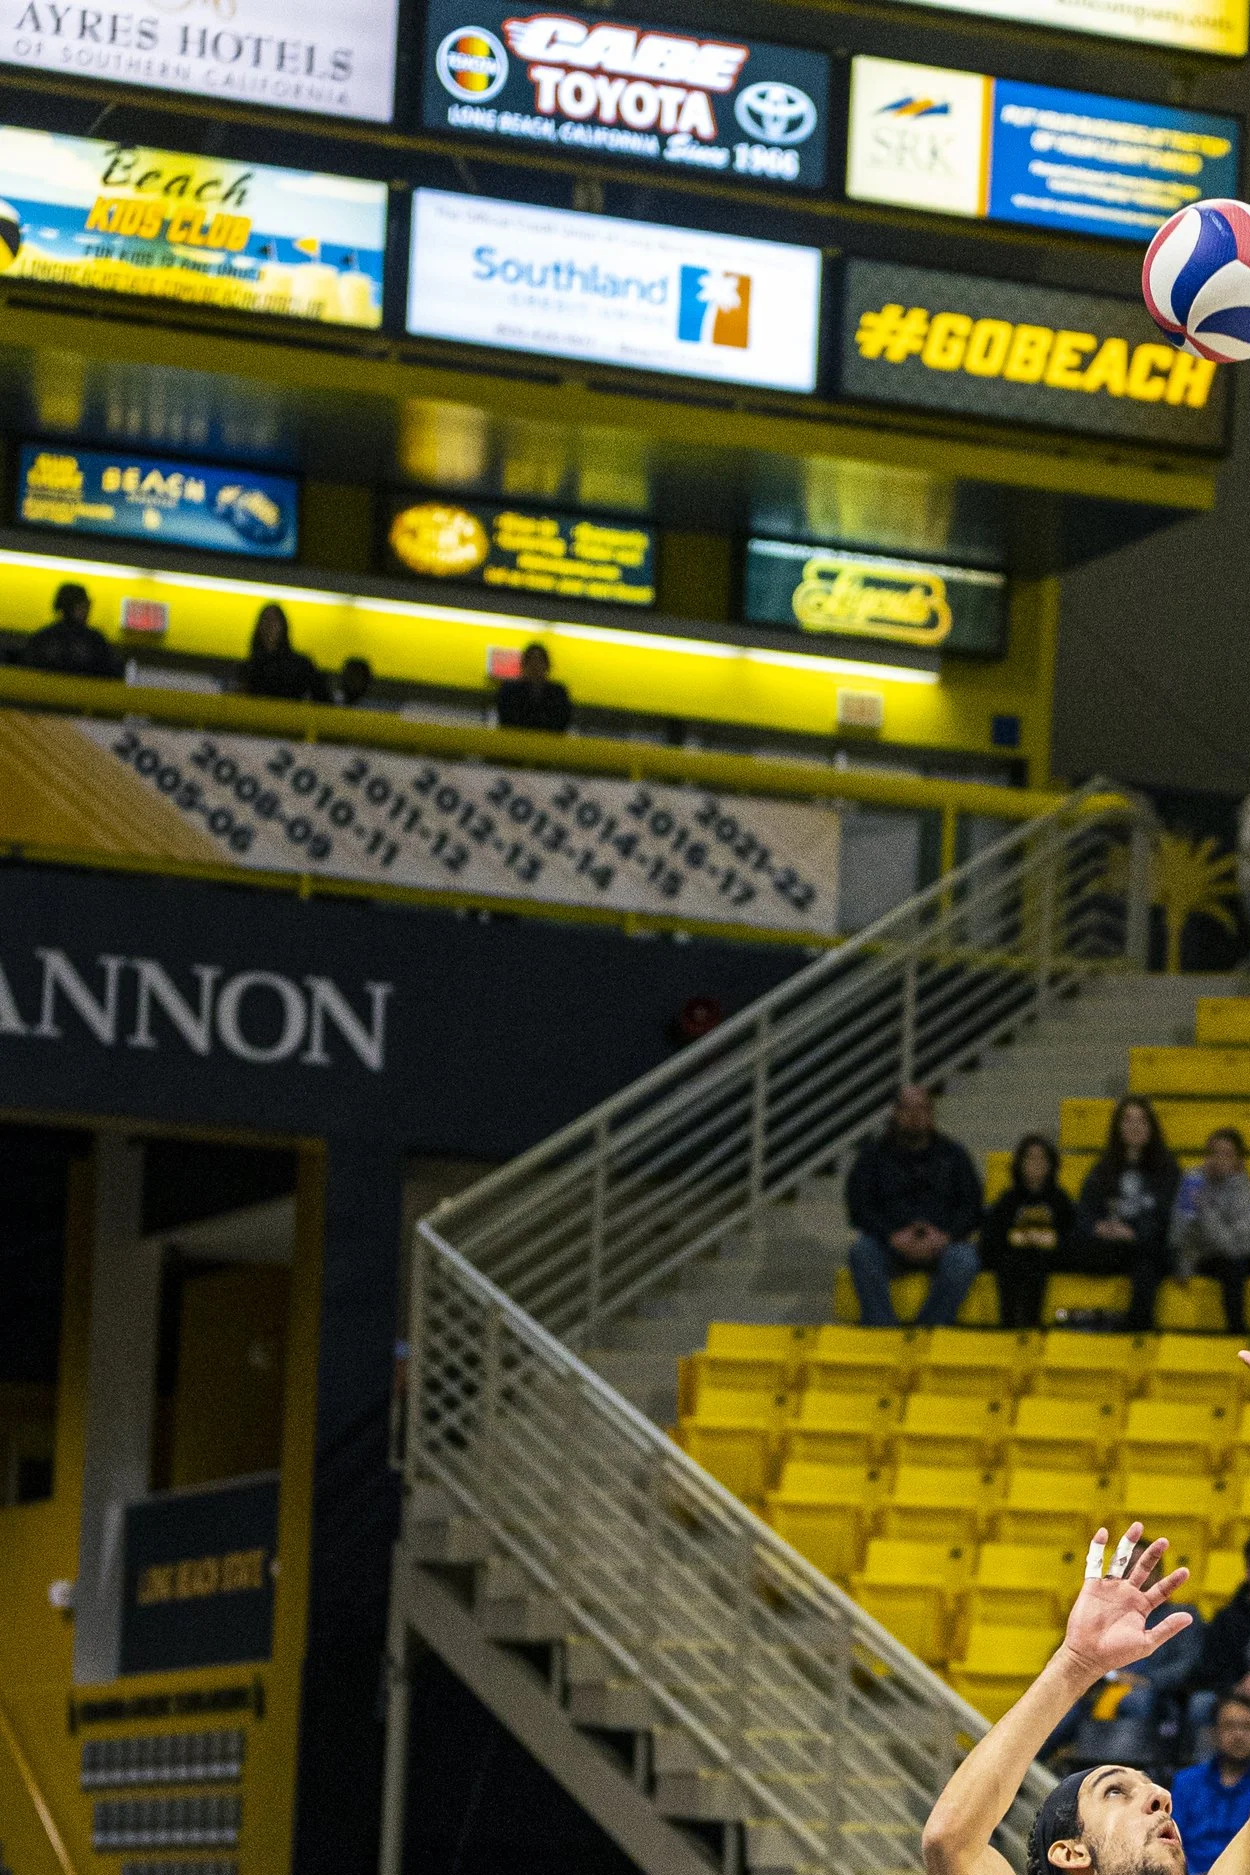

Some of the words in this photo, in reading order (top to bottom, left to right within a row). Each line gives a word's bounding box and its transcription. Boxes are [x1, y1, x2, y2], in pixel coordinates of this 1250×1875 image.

[14, 36, 42, 57] OF
[62, 46, 192, 80] SOUTHERN
[204, 68, 350, 104] CALIFORNIA
[15, 2, 158, 51] AYRES
[180, 25, 352, 82] HOTELS
[502, 13, 750, 92] CABE
[528, 64, 717, 140] TOYOTA
[101, 143, 255, 207] Beach
[448, 104, 498, 131] LONG
[558, 121, 661, 157] CALIFORNIA
[732, 142, 801, 181] 1966
[869, 122, 957, 177] SRK
[85, 197, 165, 240] KIDS
[166, 204, 253, 252] CLUB
[472, 245, 669, 306] Southland
[854, 302, 1218, 409] #GOBEACH
[266, 749, 399, 869] 2010-11
[343, 757, 470, 875] 2011-12
[412, 766, 542, 882] 2012-13
